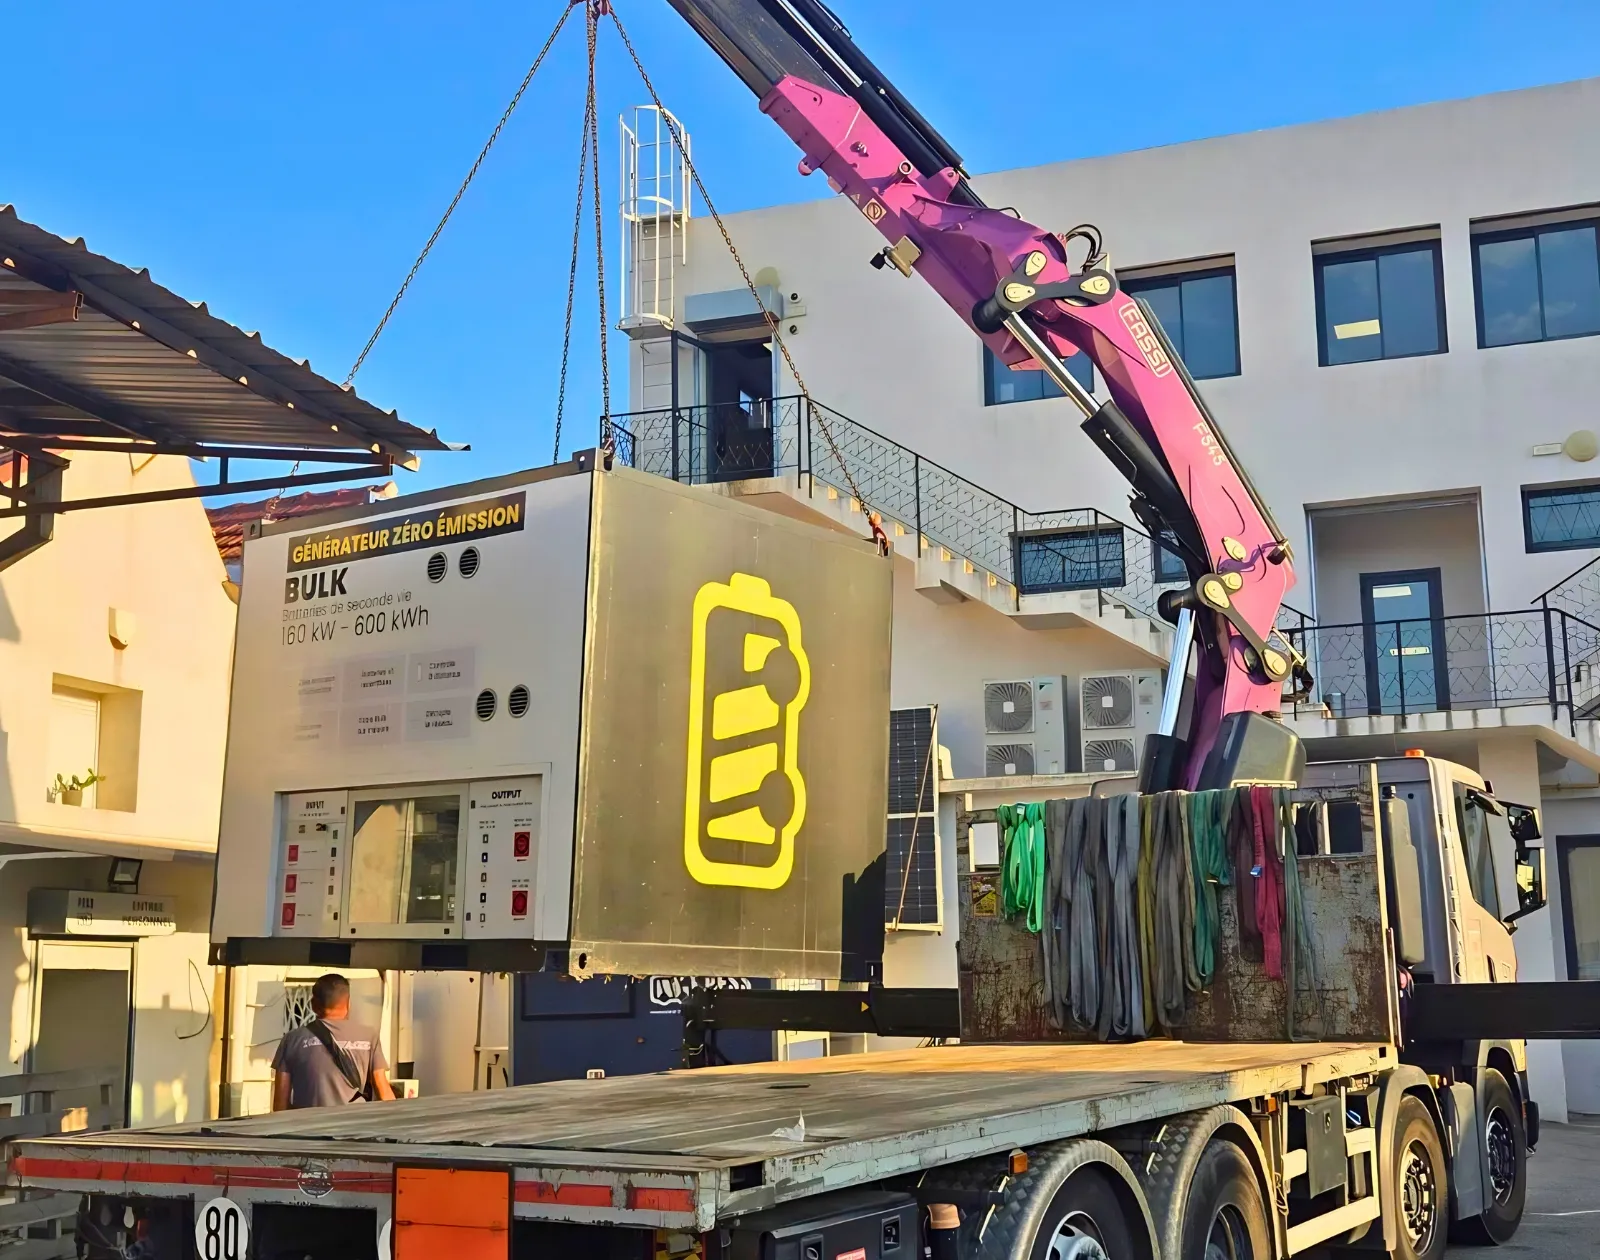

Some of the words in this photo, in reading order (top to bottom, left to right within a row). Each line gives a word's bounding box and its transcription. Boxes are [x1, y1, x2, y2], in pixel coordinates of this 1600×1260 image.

[1123, 308, 1170, 373] FASSI
[1192, 421, 1227, 466] F545
[292, 529, 390, 564] GÉNÉRATEUR
[392, 518, 433, 546] ZÉRO
[436, 503, 520, 537] ÉMISSION
[284, 566, 349, 604] BULK
[347, 592, 393, 612] seconde
[282, 623, 306, 645] 160
[311, 620, 337, 642] kW
[354, 611, 386, 636] 600
[391, 605, 429, 631] kWh
[491, 789, 522, 800] OUTPUT
[205, 1206, 239, 1260] 80
